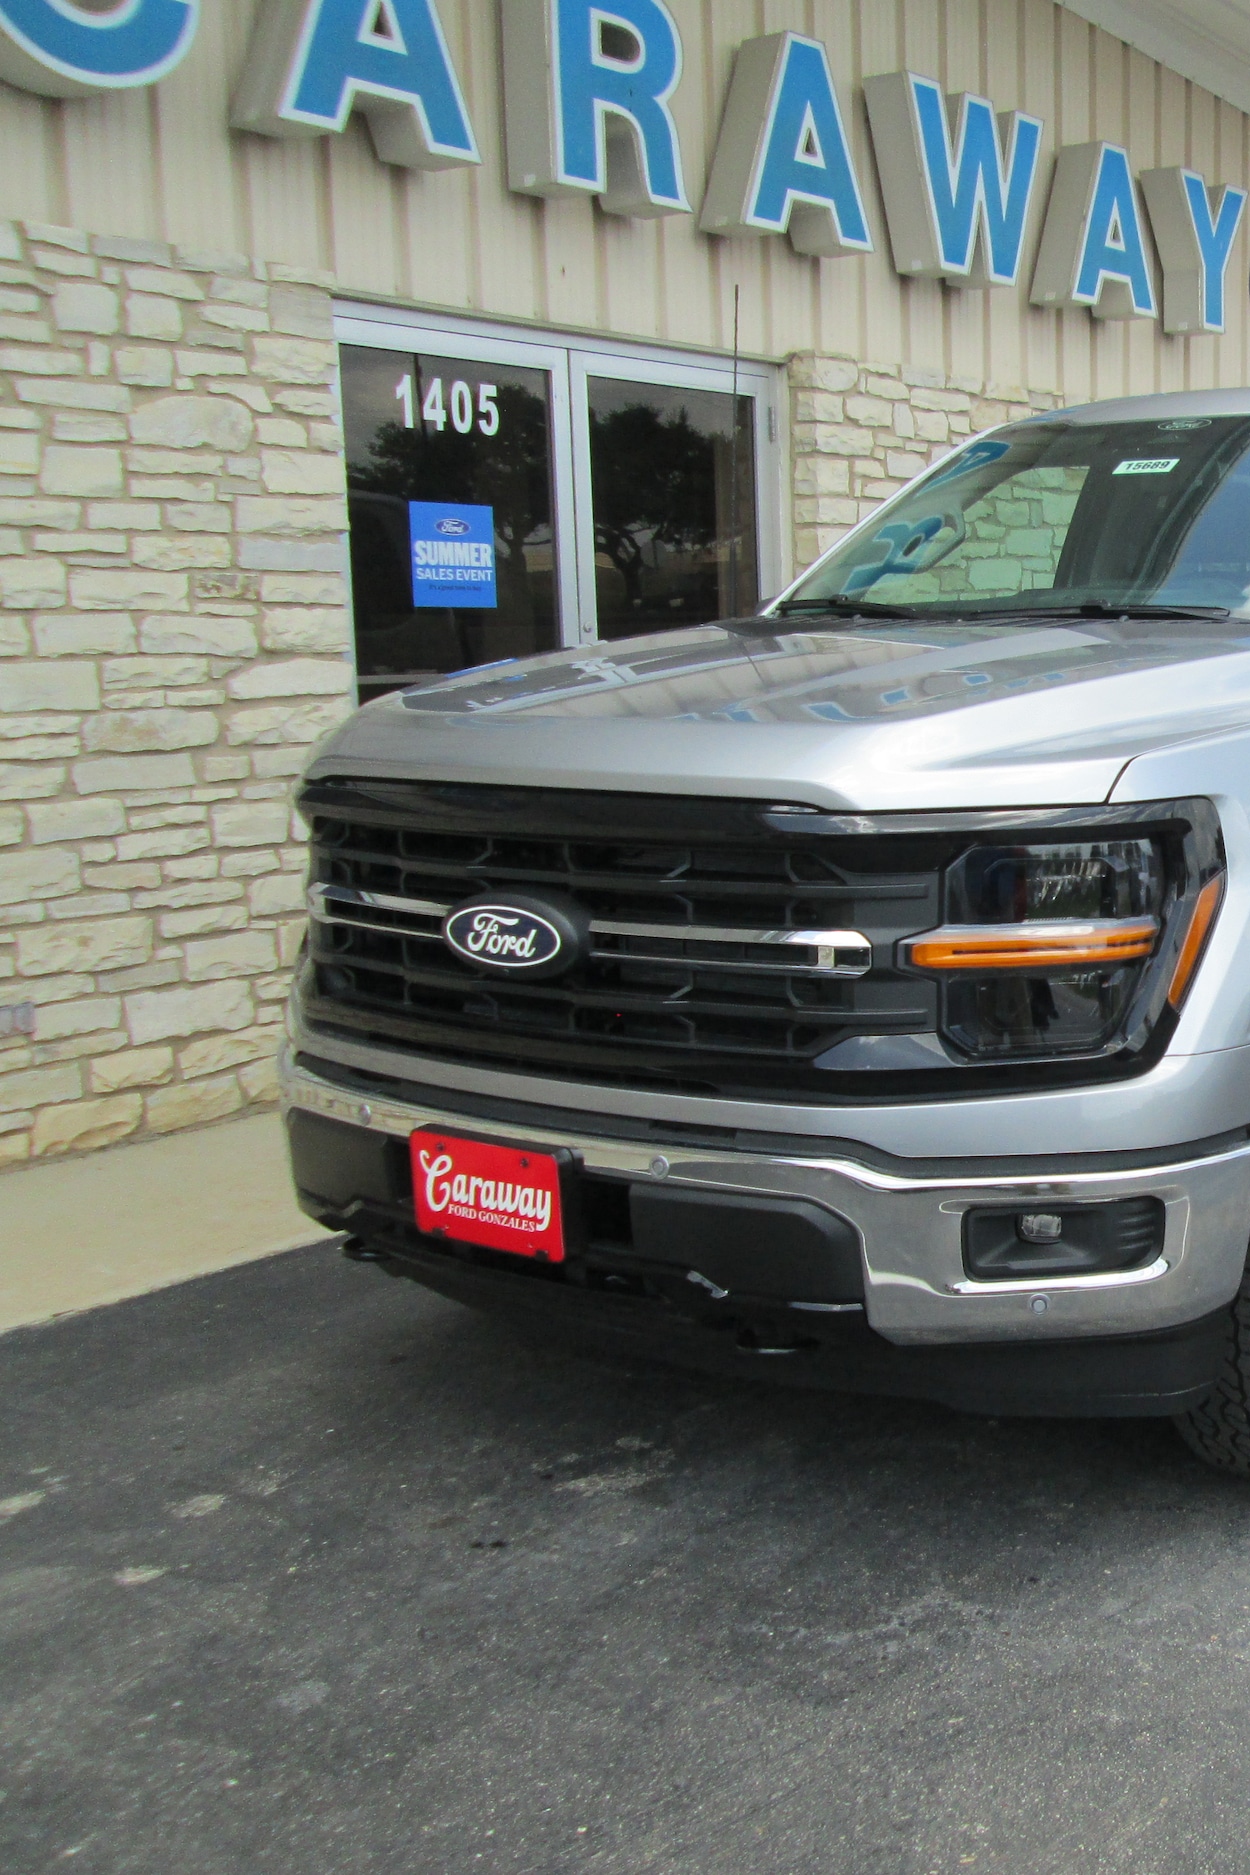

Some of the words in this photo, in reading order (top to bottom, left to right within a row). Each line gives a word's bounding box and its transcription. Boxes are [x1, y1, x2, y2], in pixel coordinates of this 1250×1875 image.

[395, 374, 499, 436] 1405
[1125, 461, 1171, 471] 15689
[441, 521, 464, 533] Ford
[415, 540, 492, 567] SUMMER
[416, 567, 454, 580] SALES
[456, 569, 493, 581] EVENT
[467, 913, 538, 958] Ford
[419, 1150, 552, 1231] Caraway
[447, 1204, 477, 1220] FORD
[478, 1210, 537, 1233] GONZALES
